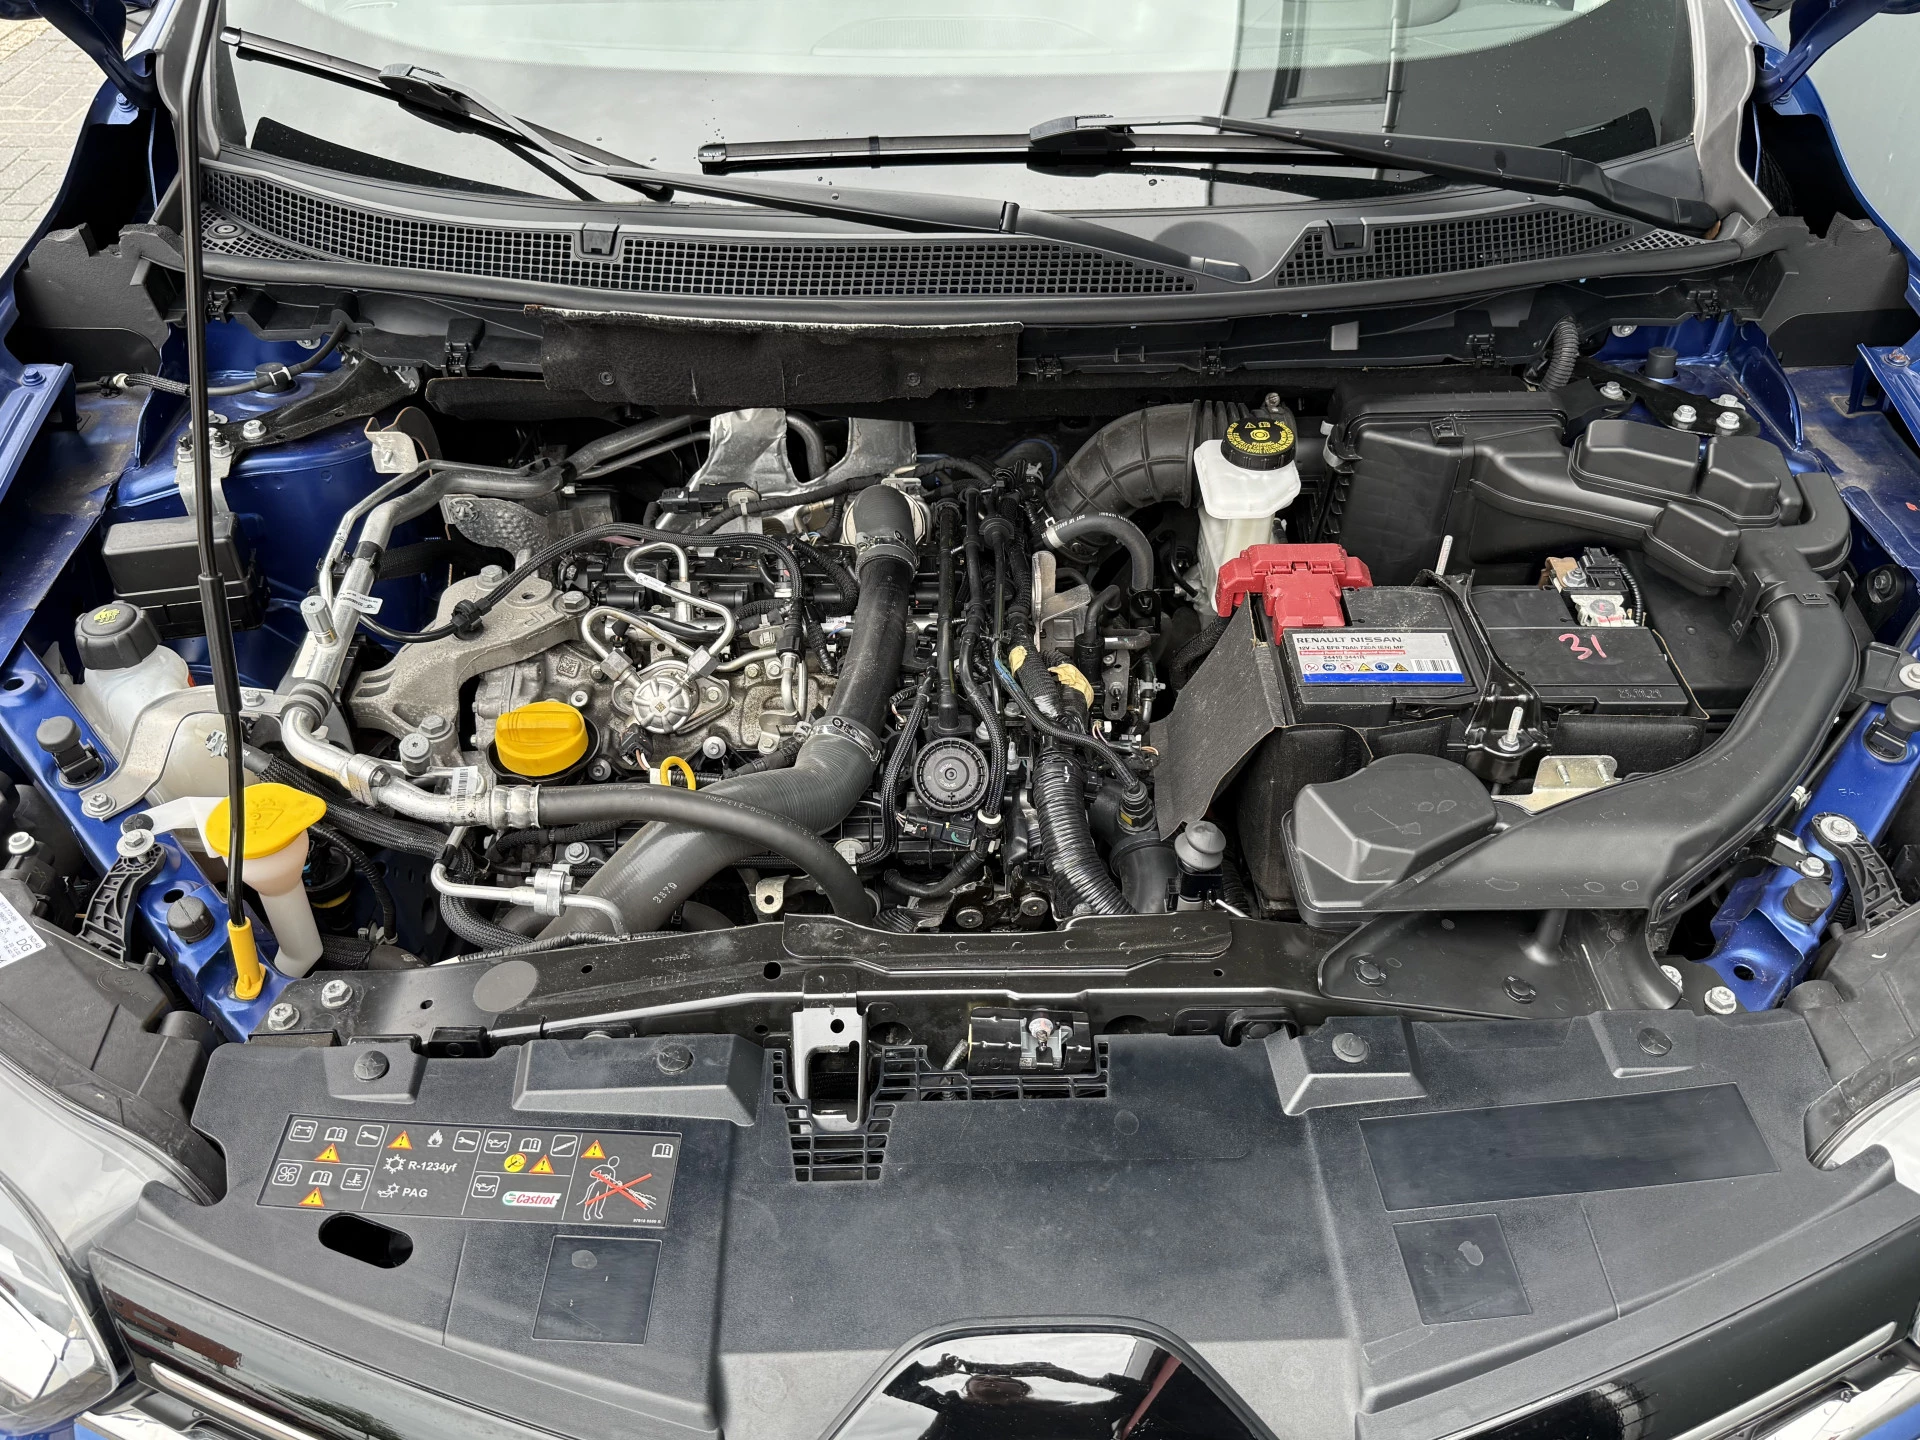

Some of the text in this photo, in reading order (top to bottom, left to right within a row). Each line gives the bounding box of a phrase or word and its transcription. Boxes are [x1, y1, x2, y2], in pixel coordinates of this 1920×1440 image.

[1558, 633, 1607, 660] 31
[408, 1160, 458, 1174] R-1234yf
[402, 1187, 428, 1198] PAG
[516, 1193, 556, 1205] Castrol
